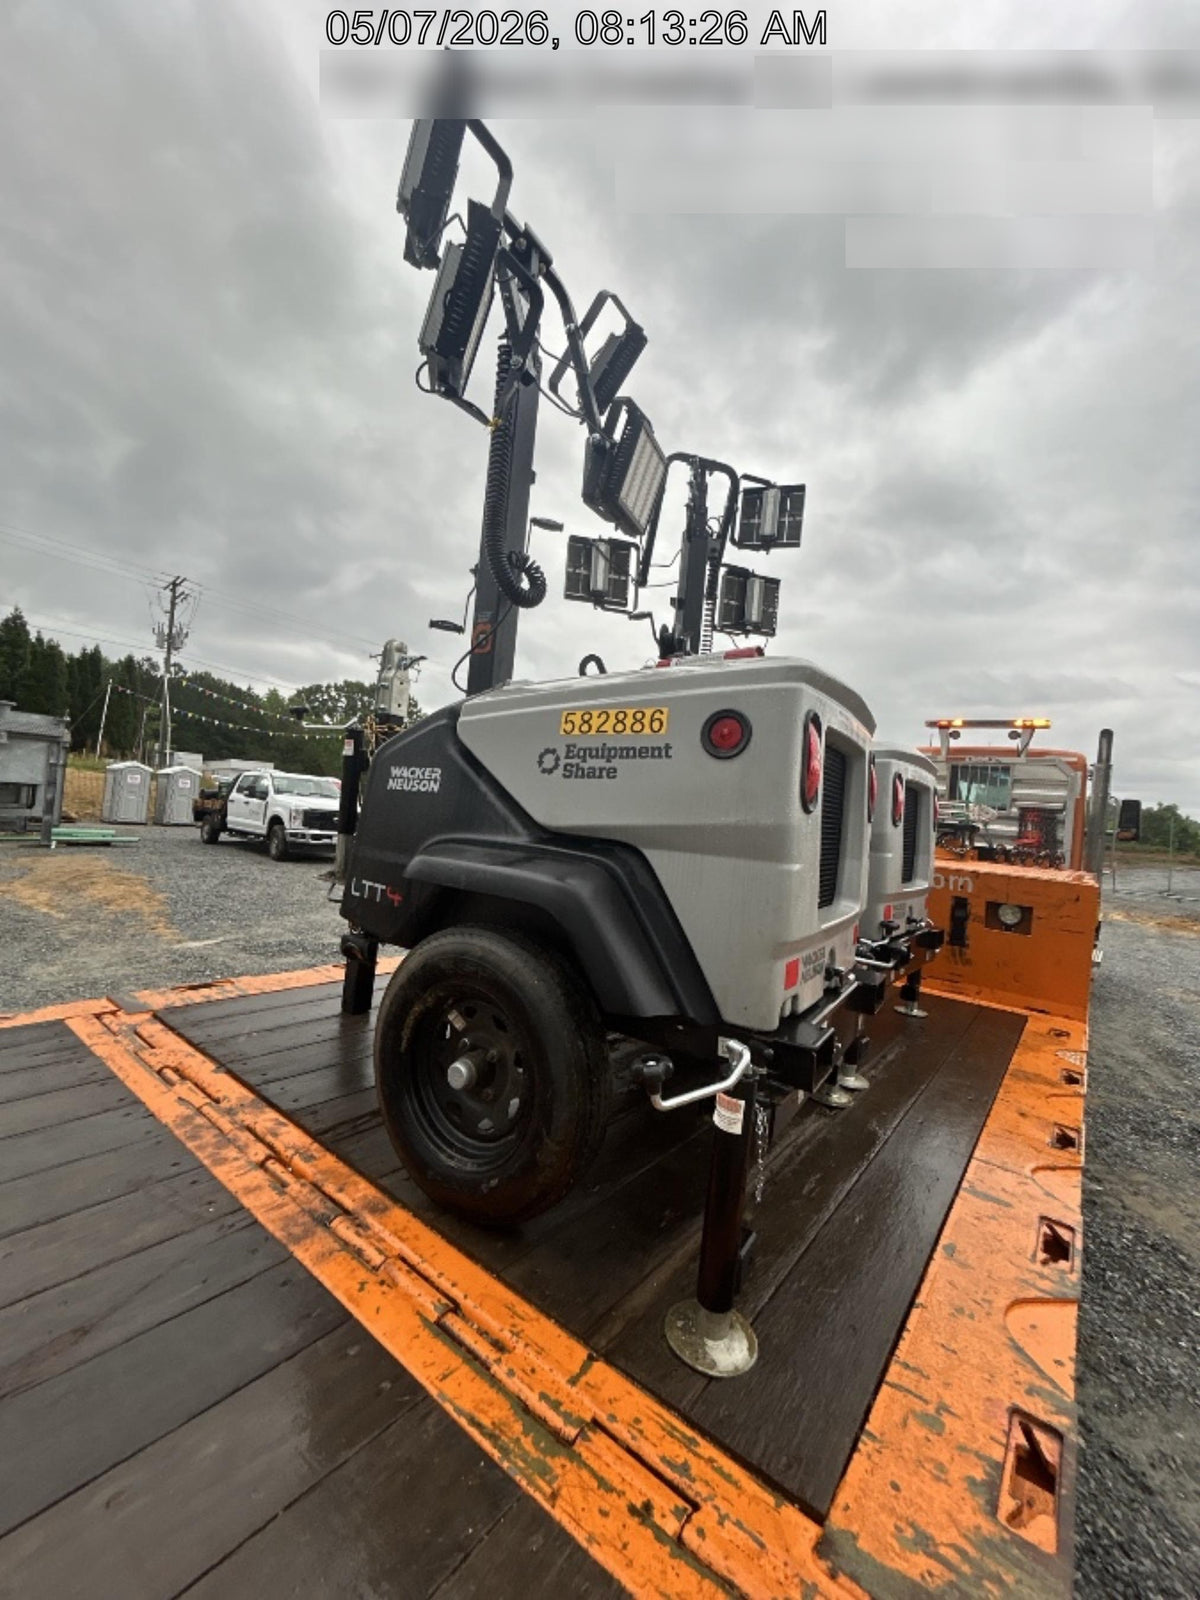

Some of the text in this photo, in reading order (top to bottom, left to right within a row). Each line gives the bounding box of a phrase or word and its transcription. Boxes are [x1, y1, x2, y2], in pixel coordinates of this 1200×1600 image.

[562, 708, 666, 735] 582886
[564, 743, 673, 762] Equipment
[389, 766, 442, 780] WACKER
[562, 763, 618, 779] Share
[386, 778, 440, 793] NEUSON
[351, 877, 403, 907] LTT4
